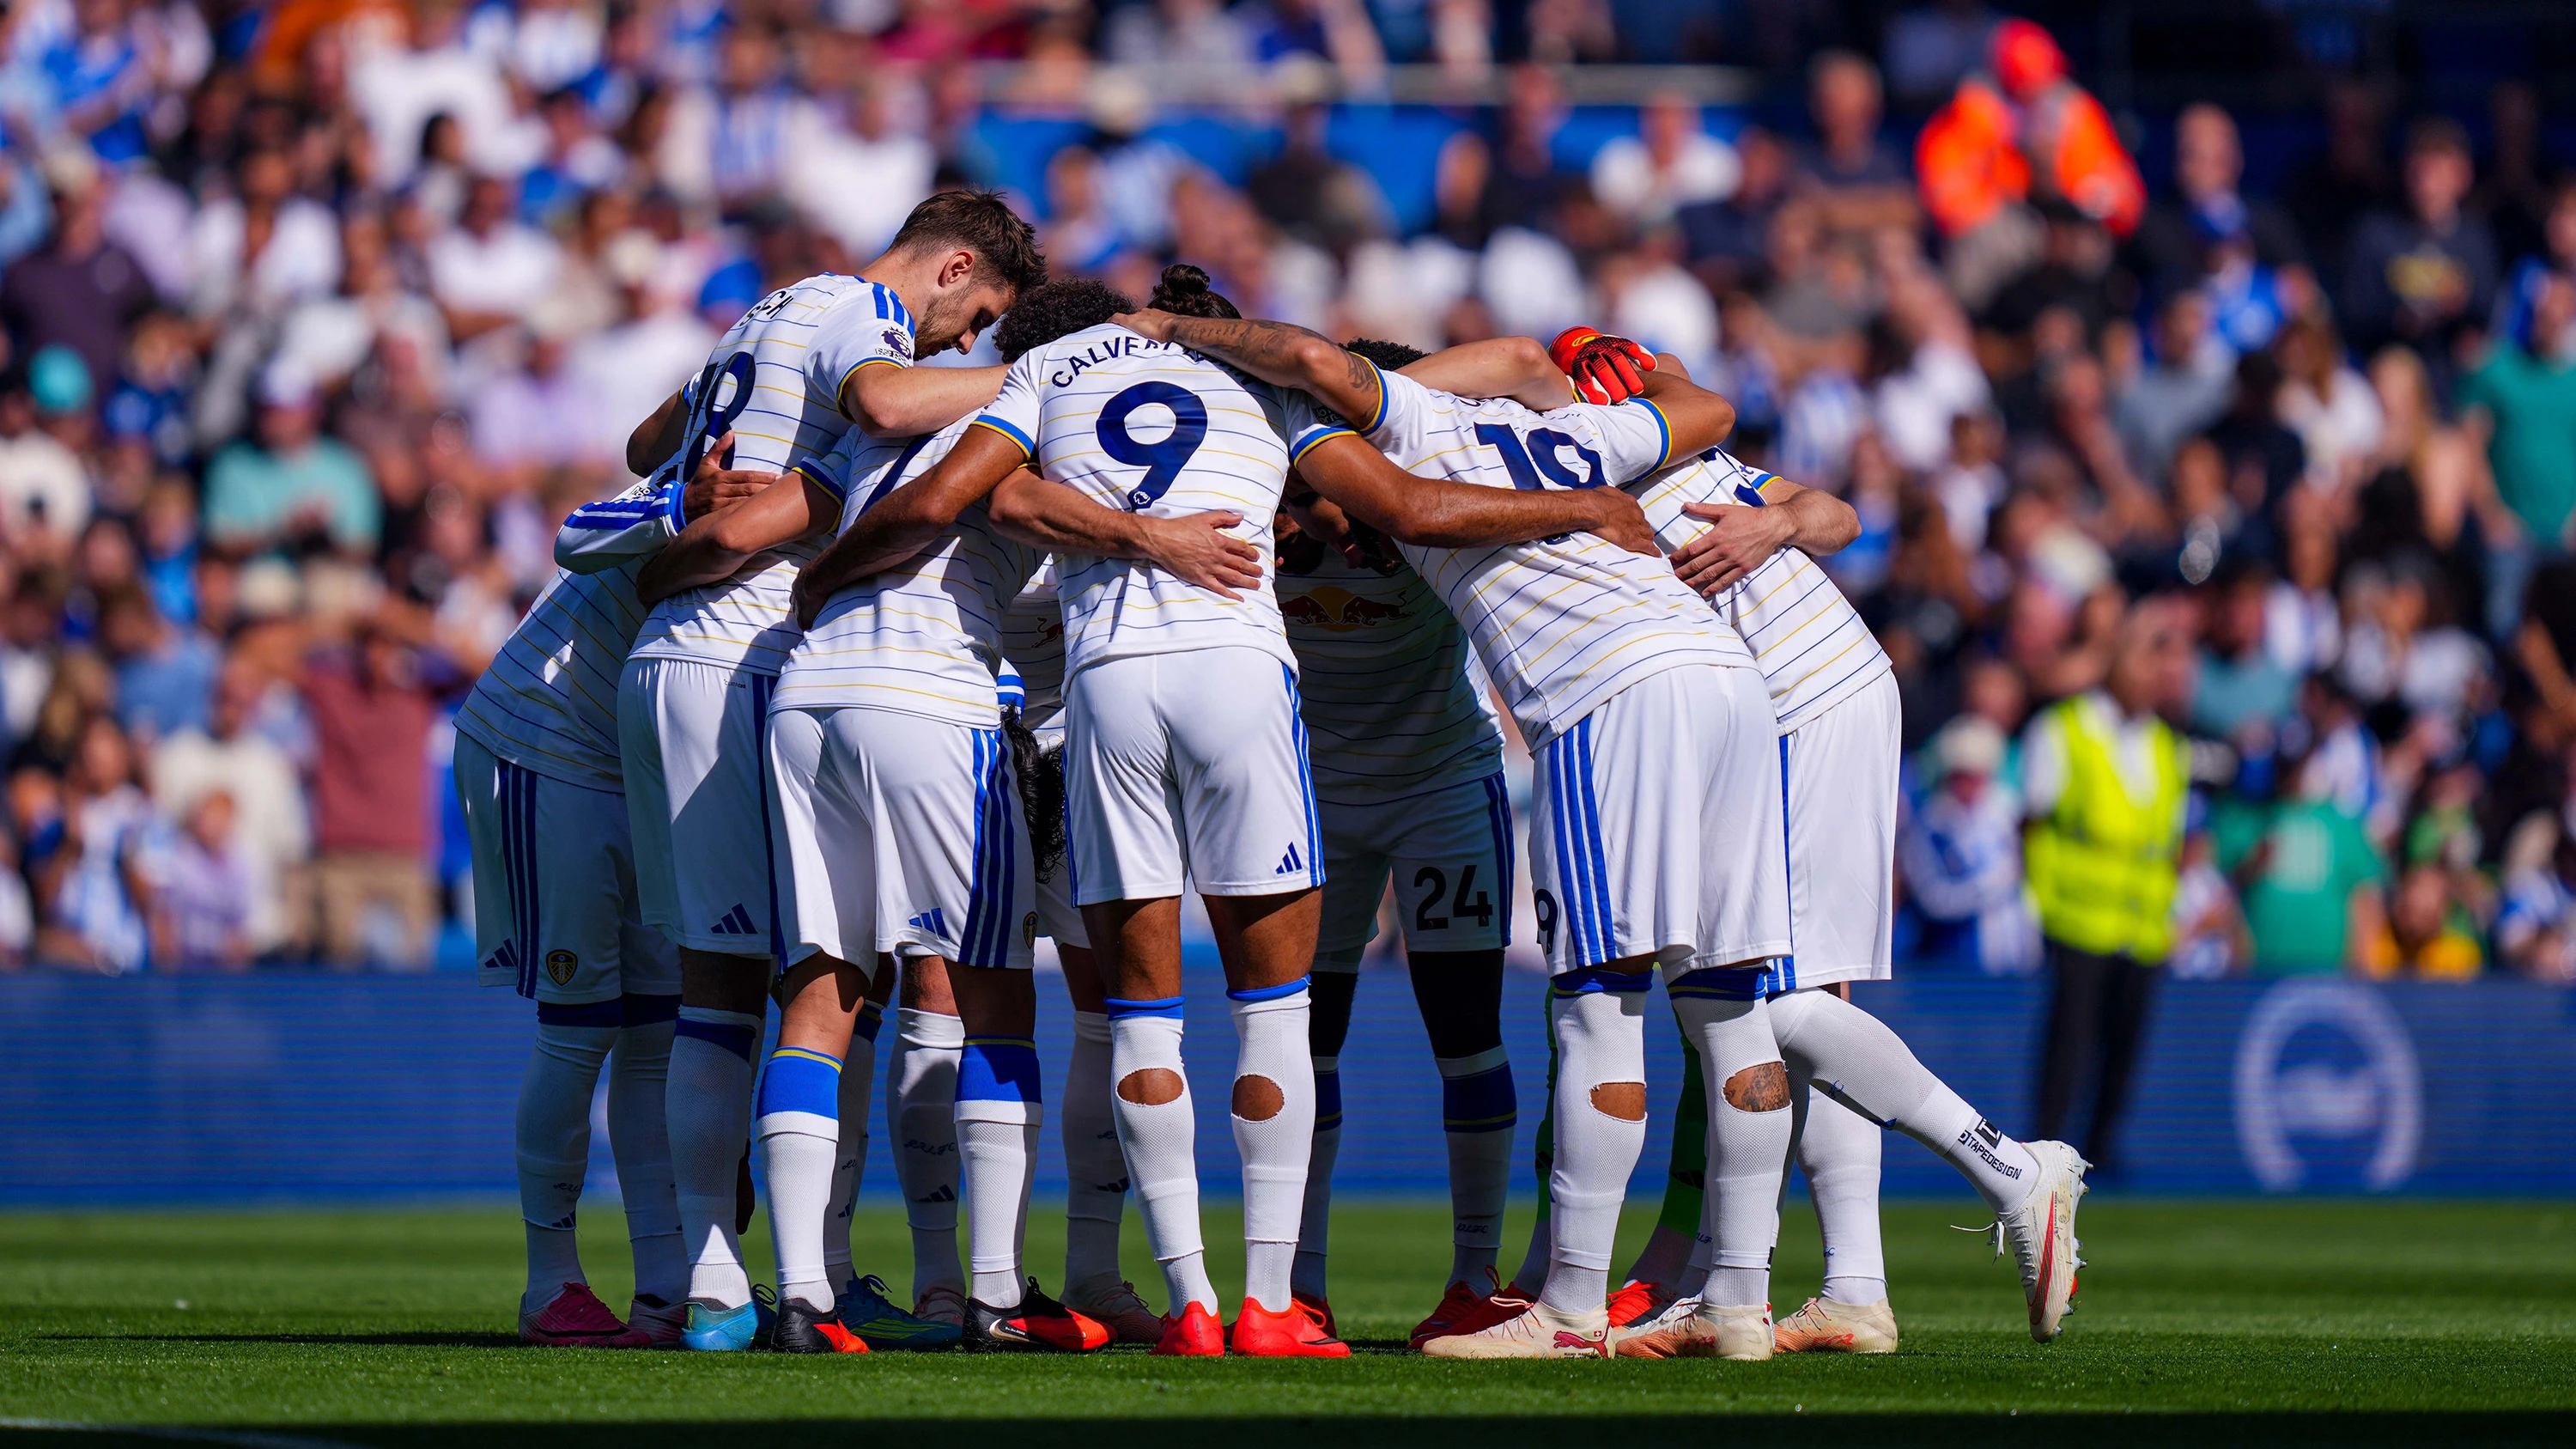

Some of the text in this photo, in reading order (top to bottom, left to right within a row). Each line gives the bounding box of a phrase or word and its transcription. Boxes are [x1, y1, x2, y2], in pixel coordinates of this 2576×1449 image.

[1096, 381, 1208, 512] 9
[1413, 864, 1493, 931] 24
[1967, 1135, 2022, 1180] TAPEDESIGN
